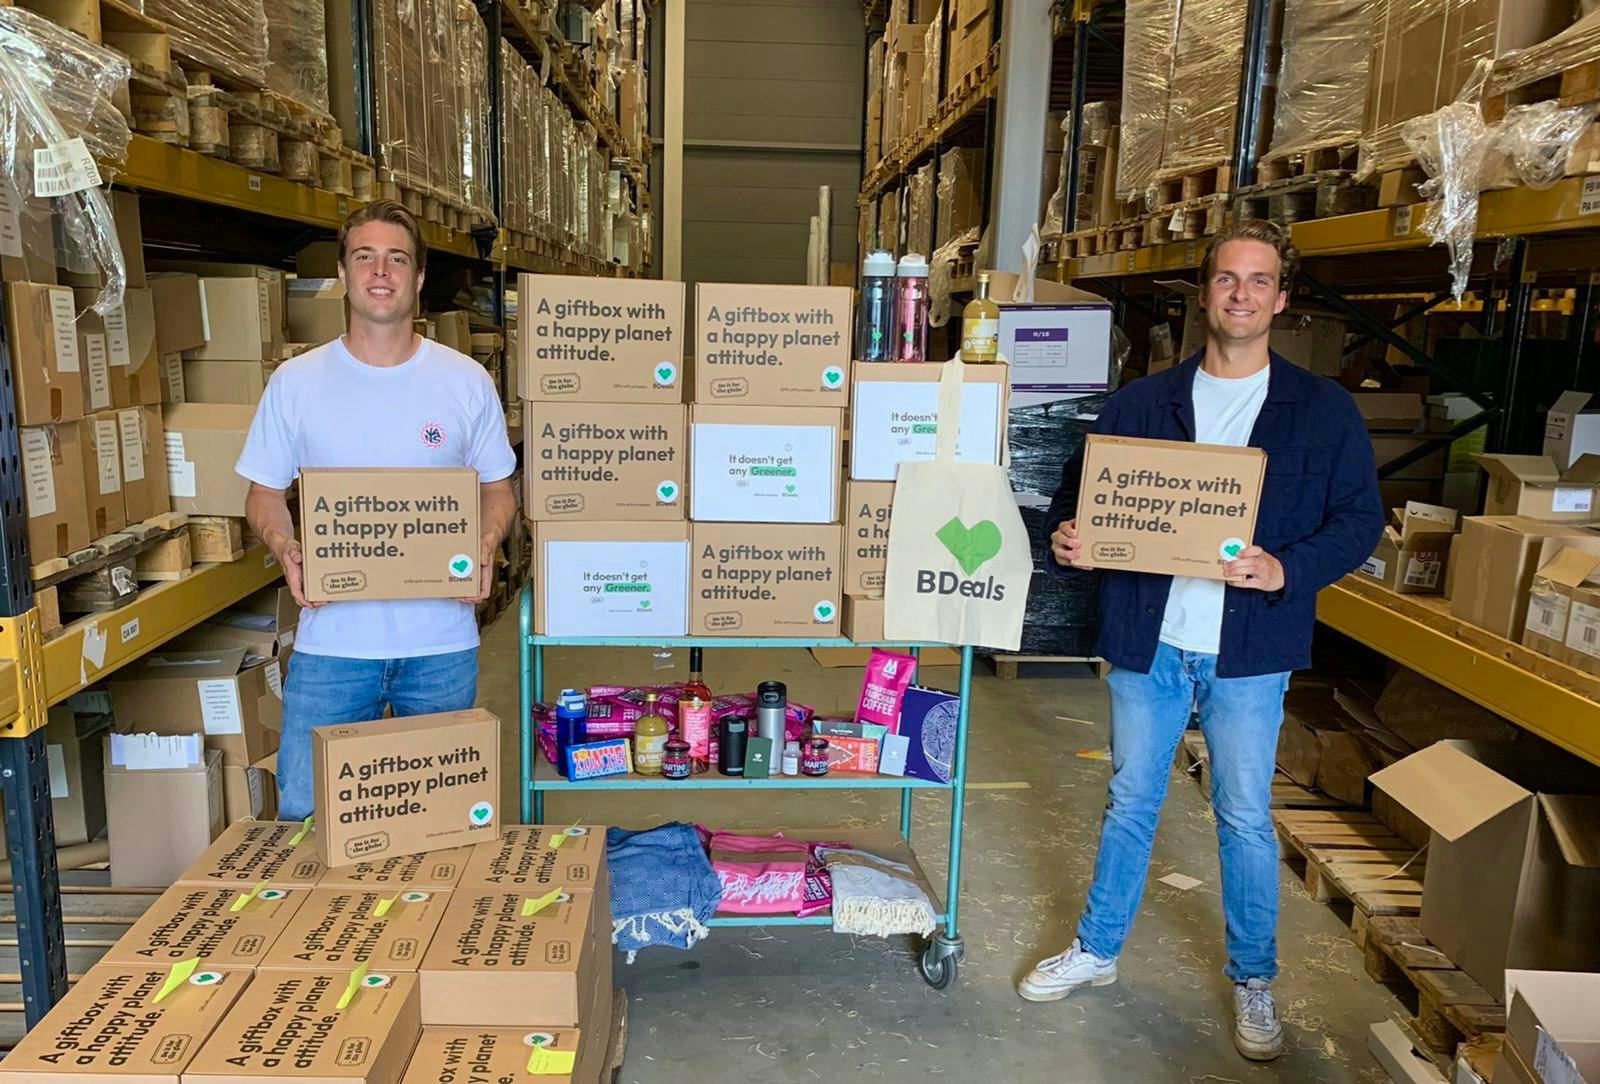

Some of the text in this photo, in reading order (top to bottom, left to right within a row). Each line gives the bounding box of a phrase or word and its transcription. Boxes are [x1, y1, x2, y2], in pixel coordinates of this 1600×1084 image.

[537, 298, 665, 320] A giftbox with
[707, 306, 834, 328] A giftbox with
[537, 322, 672, 344] a happy planet
[707, 329, 840, 350] a happy planet
[537, 344, 616, 362] attitude.
[707, 350, 782, 366] attitude.
[891, 412, 938, 422] It doesn't
[542, 422, 668, 444] A giftbox with
[890, 426, 910, 435] any
[542, 446, 675, 466] a happy planet
[729, 454, 793, 466] It doesn't get
[542, 467, 618, 482] attitude.
[729, 466, 796, 477] any Greener.
[1097, 467, 1242, 494] A giftbox with
[314, 495, 459, 517] A giftbox with
[859, 503, 872, 518] A
[1094, 490, 1247, 517] a happy planet
[314, 518, 468, 539] a happy planet
[858, 528, 868, 538] a
[1092, 512, 1177, 534] attitude.
[316, 541, 404, 559] attitude.
[702, 544, 825, 564] A giftbox with
[583, 572, 647, 583] It doesn't get
[702, 566, 832, 584] a happy planet
[916, 570, 1006, 601] BDeals
[583, 583, 650, 594] any Greener.
[702, 586, 776, 600] attitude.
[862, 697, 894, 716] COFFEE
[339, 746, 480, 781] A giftbox with
[339, 767, 488, 801] a happy planet
[339, 799, 427, 824] attitude.
[217, 843, 252, 871] giftbox
[244, 827, 266, 842] with
[236, 847, 274, 872] happy
[262, 825, 290, 847] planet
[501, 830, 520, 846] with
[521, 828, 542, 850] planet
[261, 847, 296, 880] attitude.
[490, 846, 513, 875] giftbox
[510, 851, 539, 876] happy
[535, 849, 558, 883] attitude.
[148, 912, 190, 946] giftbox
[180, 891, 208, 910] with
[169, 918, 214, 948] happy
[202, 889, 236, 917] planet
[495, 894, 519, 922] planet
[294, 895, 352, 961] A giftbox with
[325, 921, 364, 952] happy
[349, 892, 379, 920] planet
[452, 896, 494, 966] A giftbox with
[196, 916, 240, 958] attitude.
[352, 920, 388, 962] attitude.
[480, 924, 514, 956] happy
[508, 922, 536, 966] attitude.
[39, 975, 133, 1064] A giftbox with
[76, 972, 165, 1065] a happy planet
[225, 980, 302, 1067] A giftbox with
[262, 976, 333, 1067] a happy planet
[108, 1009, 165, 1066] attitude.
[294, 1012, 340, 1068] attitude.
[443, 1038, 468, 1065] with
[468, 1034, 497, 1073] planet
